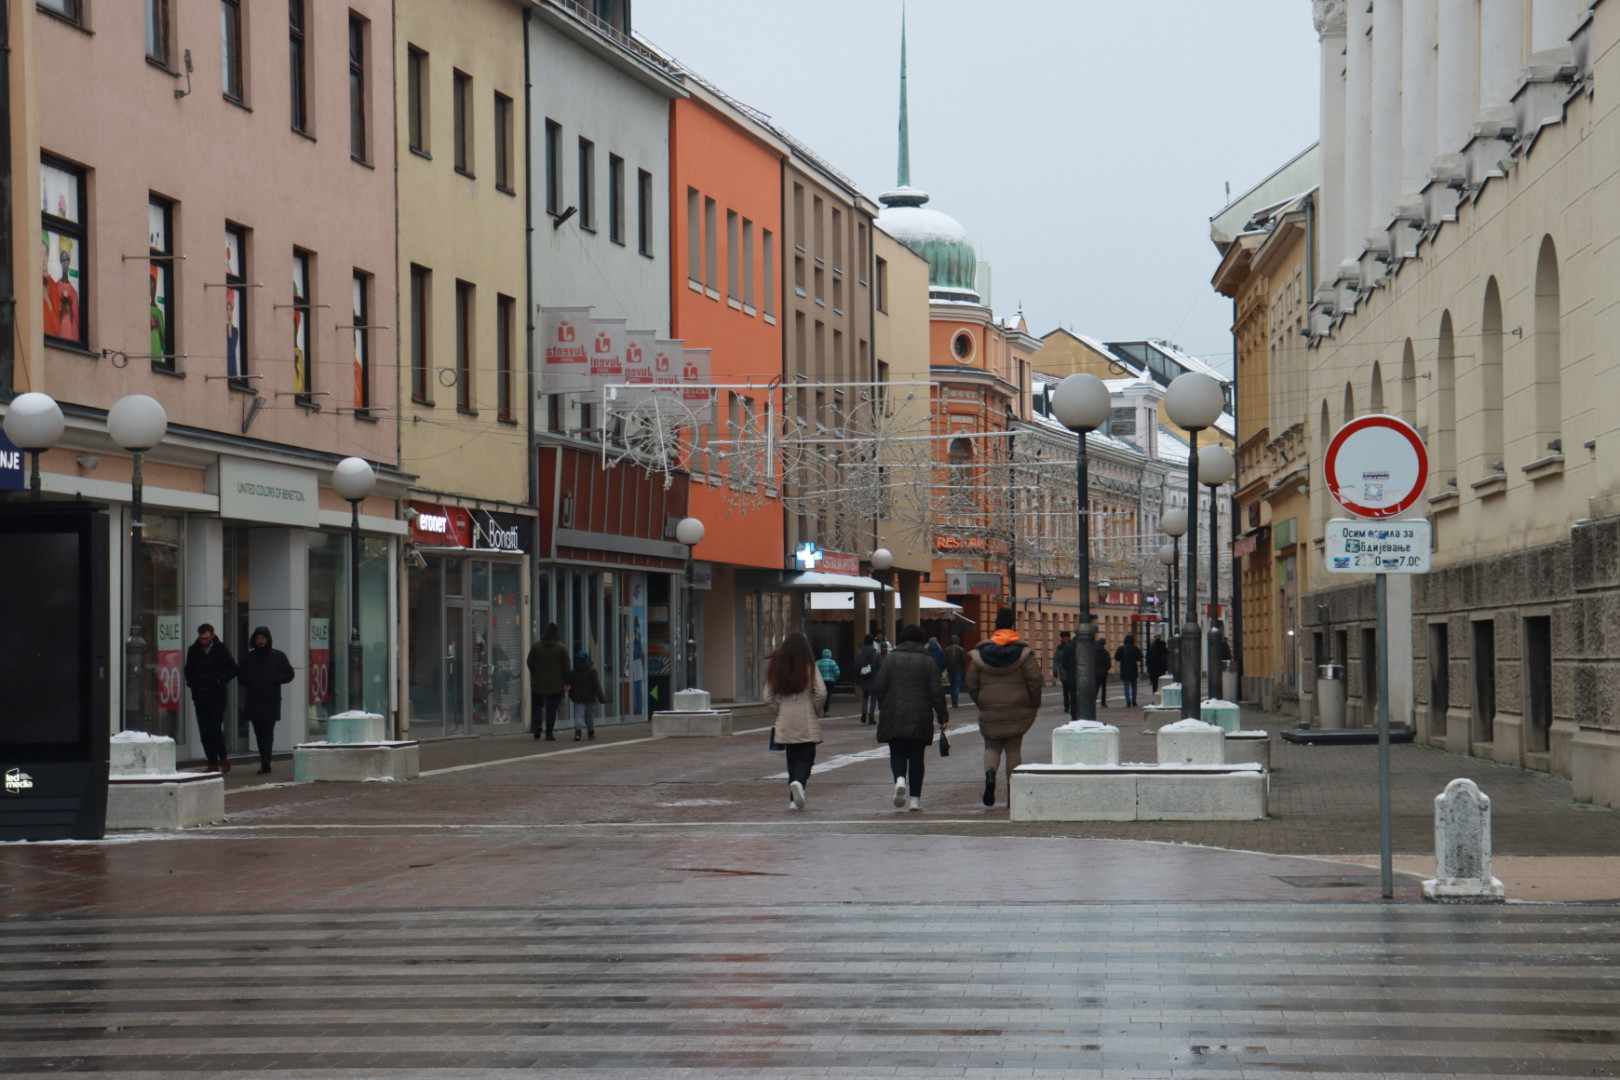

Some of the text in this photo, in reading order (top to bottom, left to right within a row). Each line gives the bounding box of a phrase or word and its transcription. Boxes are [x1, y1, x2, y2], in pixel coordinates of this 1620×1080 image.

[489, 520, 519, 549] Bonatti
[1342, 527, 1366, 538] Осим
[1402, 530, 1414, 538] за
[159, 624, 180, 640] SALE
[312, 624, 328, 640] SALE
[160, 667, 181, 704] 30
[312, 664, 328, 696] 30
